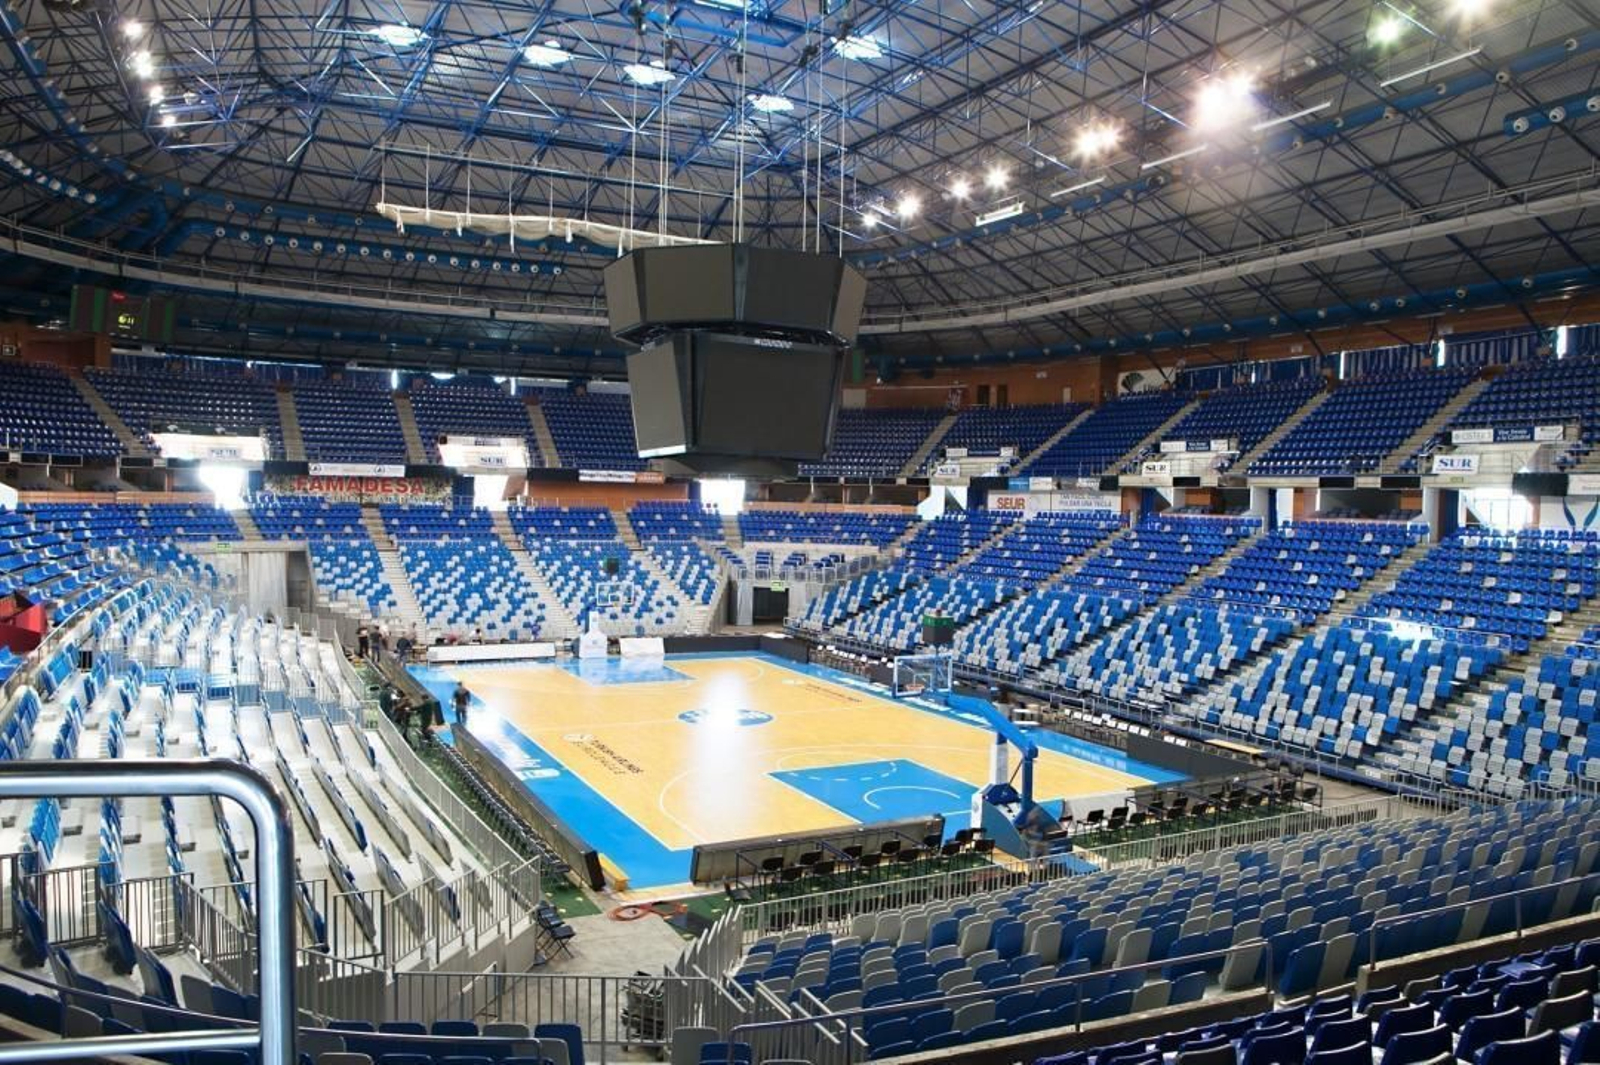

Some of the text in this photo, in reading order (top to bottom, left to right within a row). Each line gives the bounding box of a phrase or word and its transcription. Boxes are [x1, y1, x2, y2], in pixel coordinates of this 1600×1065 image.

[1438, 457, 1472, 468] SUR
[294, 476, 424, 494] FAMADESA
[996, 496, 1026, 510] SEUR
